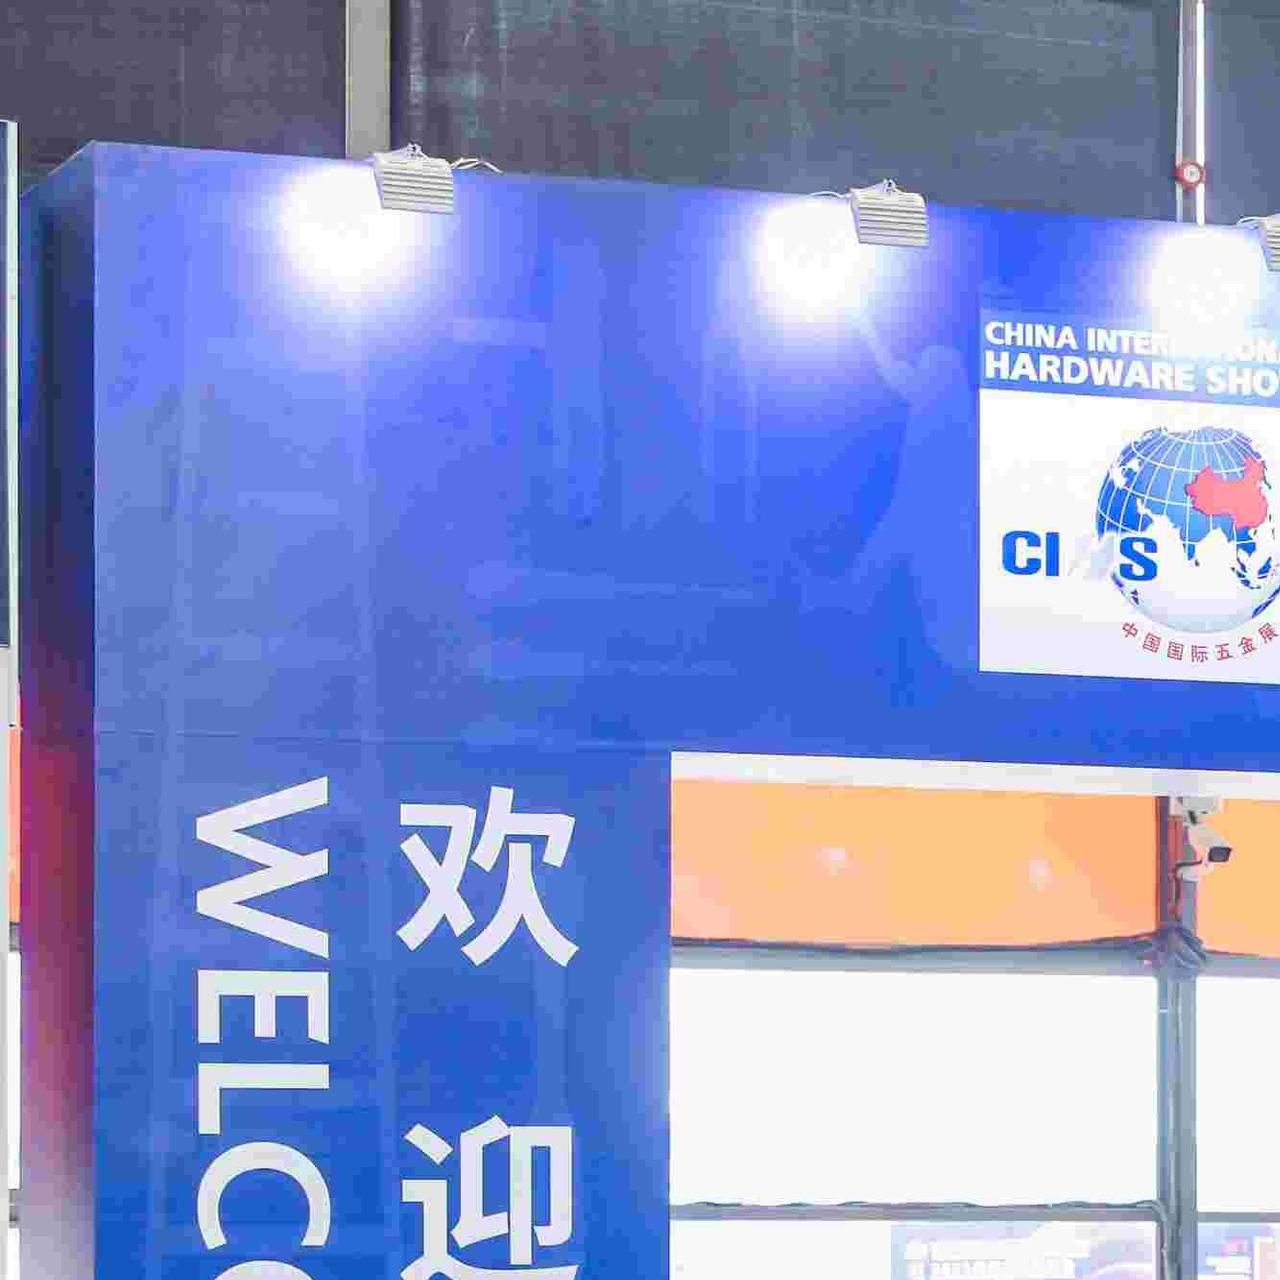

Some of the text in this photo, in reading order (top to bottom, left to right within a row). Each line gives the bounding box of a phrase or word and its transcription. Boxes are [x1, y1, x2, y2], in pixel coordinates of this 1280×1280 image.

[984, 321, 1079, 352] CHINA
[984, 350, 1197, 393] HARDWARE
[1121, 621, 1280, 664] 中国国际五金展
